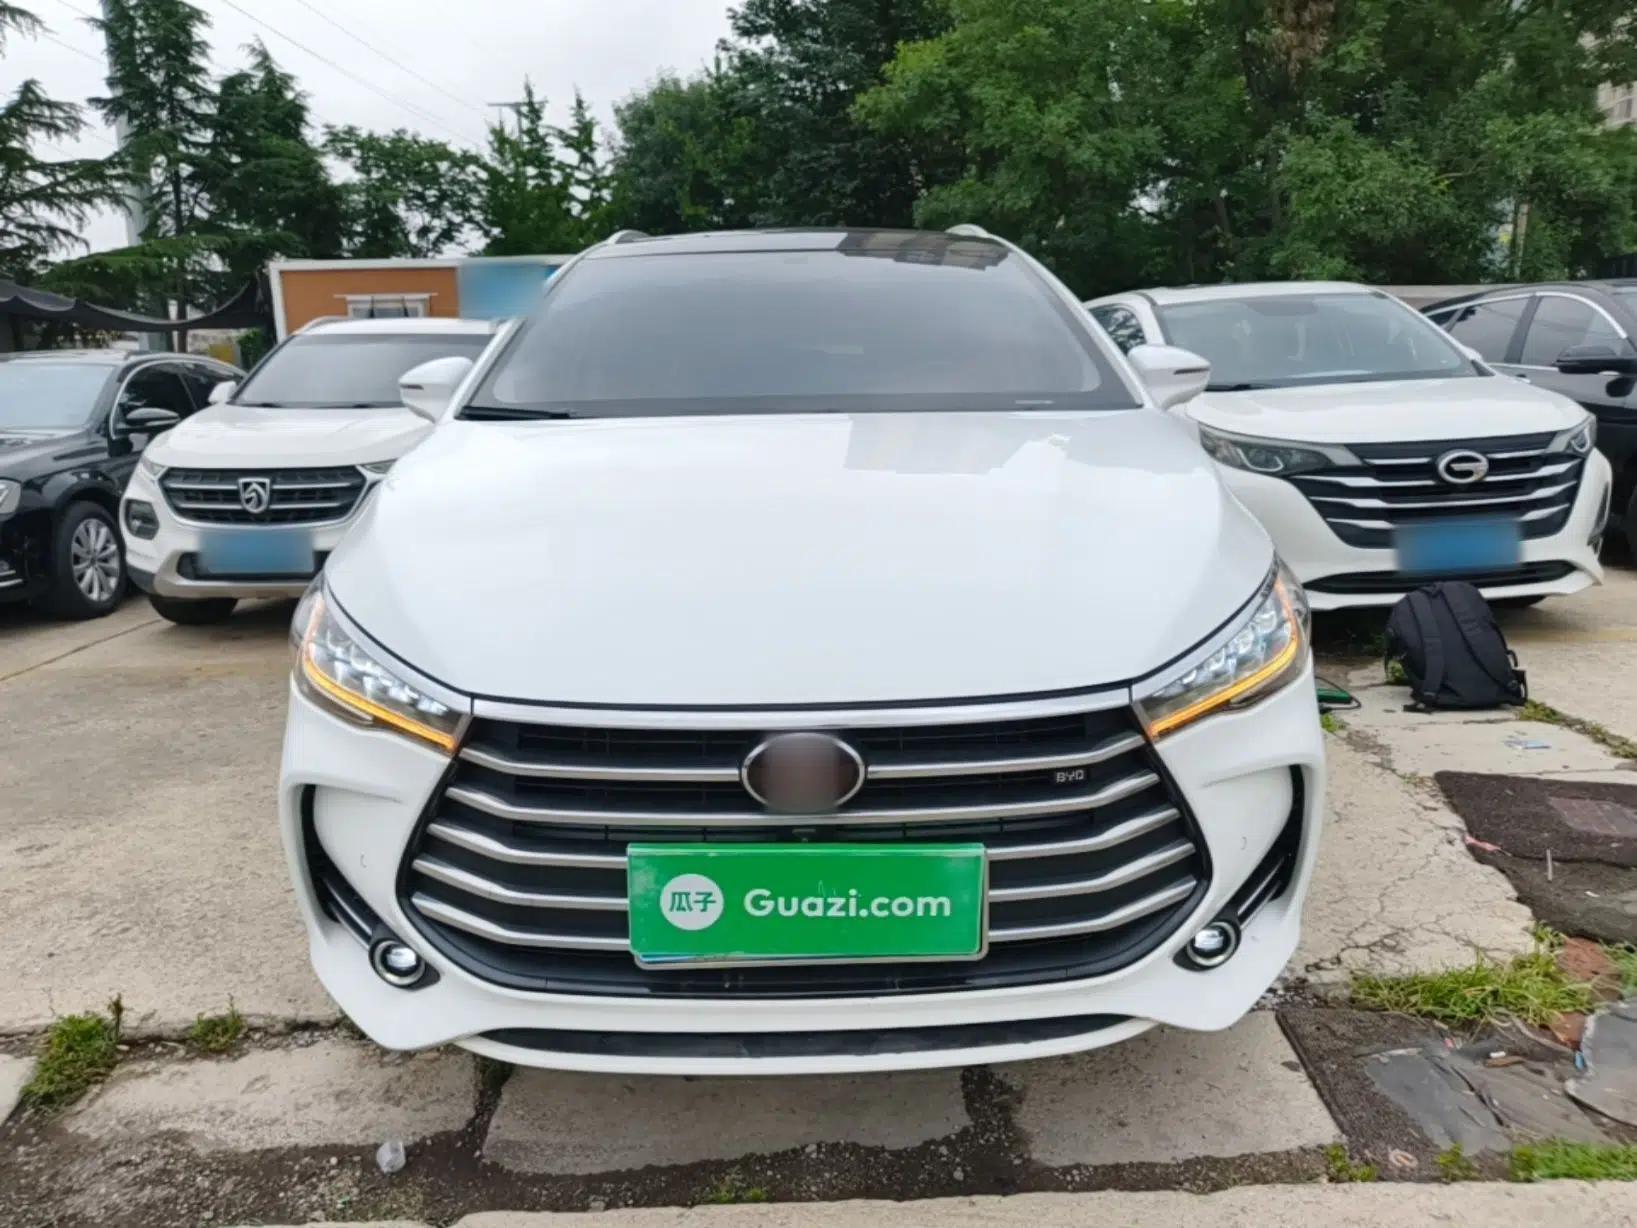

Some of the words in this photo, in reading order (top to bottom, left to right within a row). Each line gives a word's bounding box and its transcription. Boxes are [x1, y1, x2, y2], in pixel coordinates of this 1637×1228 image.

[1056, 769, 1084, 783] BYD
[669, 891, 716, 912] 瓜子
[743, 888, 951, 917] Guazi.com
